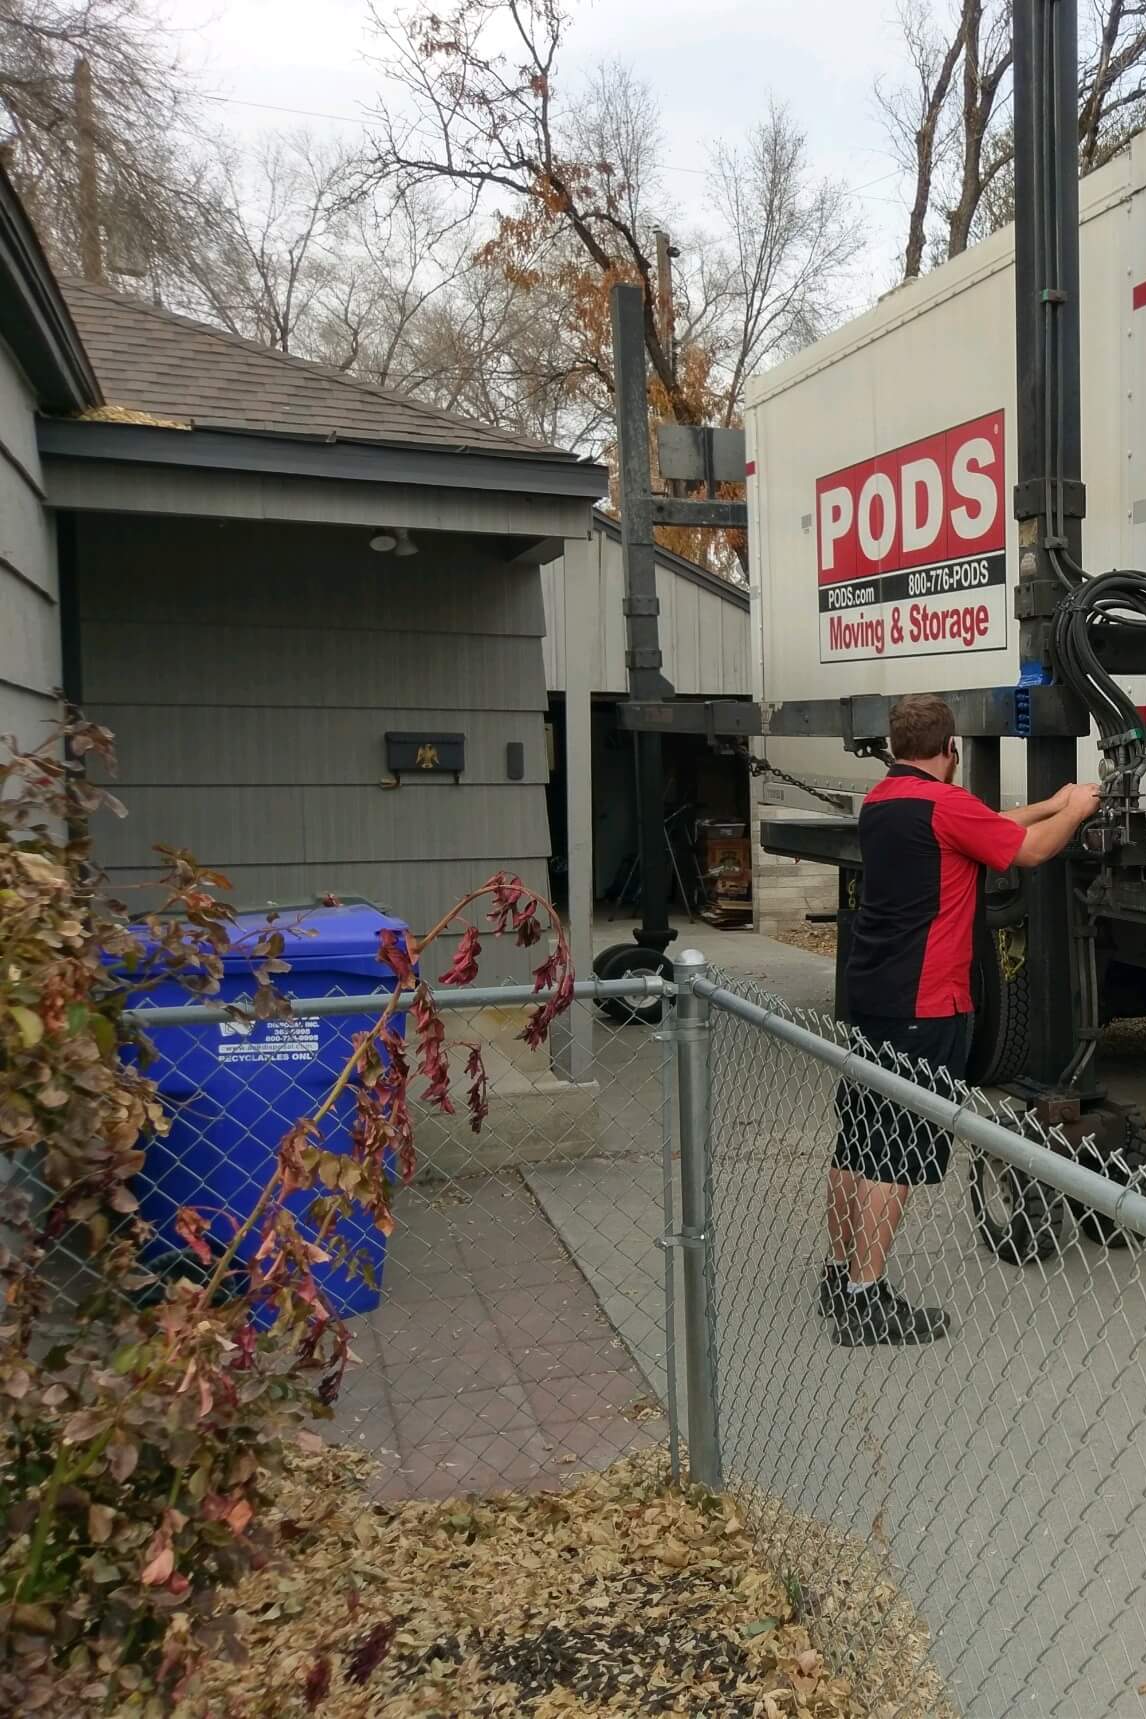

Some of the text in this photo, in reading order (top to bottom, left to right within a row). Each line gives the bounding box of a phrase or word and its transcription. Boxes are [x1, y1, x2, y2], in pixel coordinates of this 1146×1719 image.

[819, 437, 998, 571] PODS
[828, 560, 989, 609] PODS.com 800-776-PODS
[829, 603, 990, 654] Moving & Storage
[292, 1053, 315, 1061] ONL
